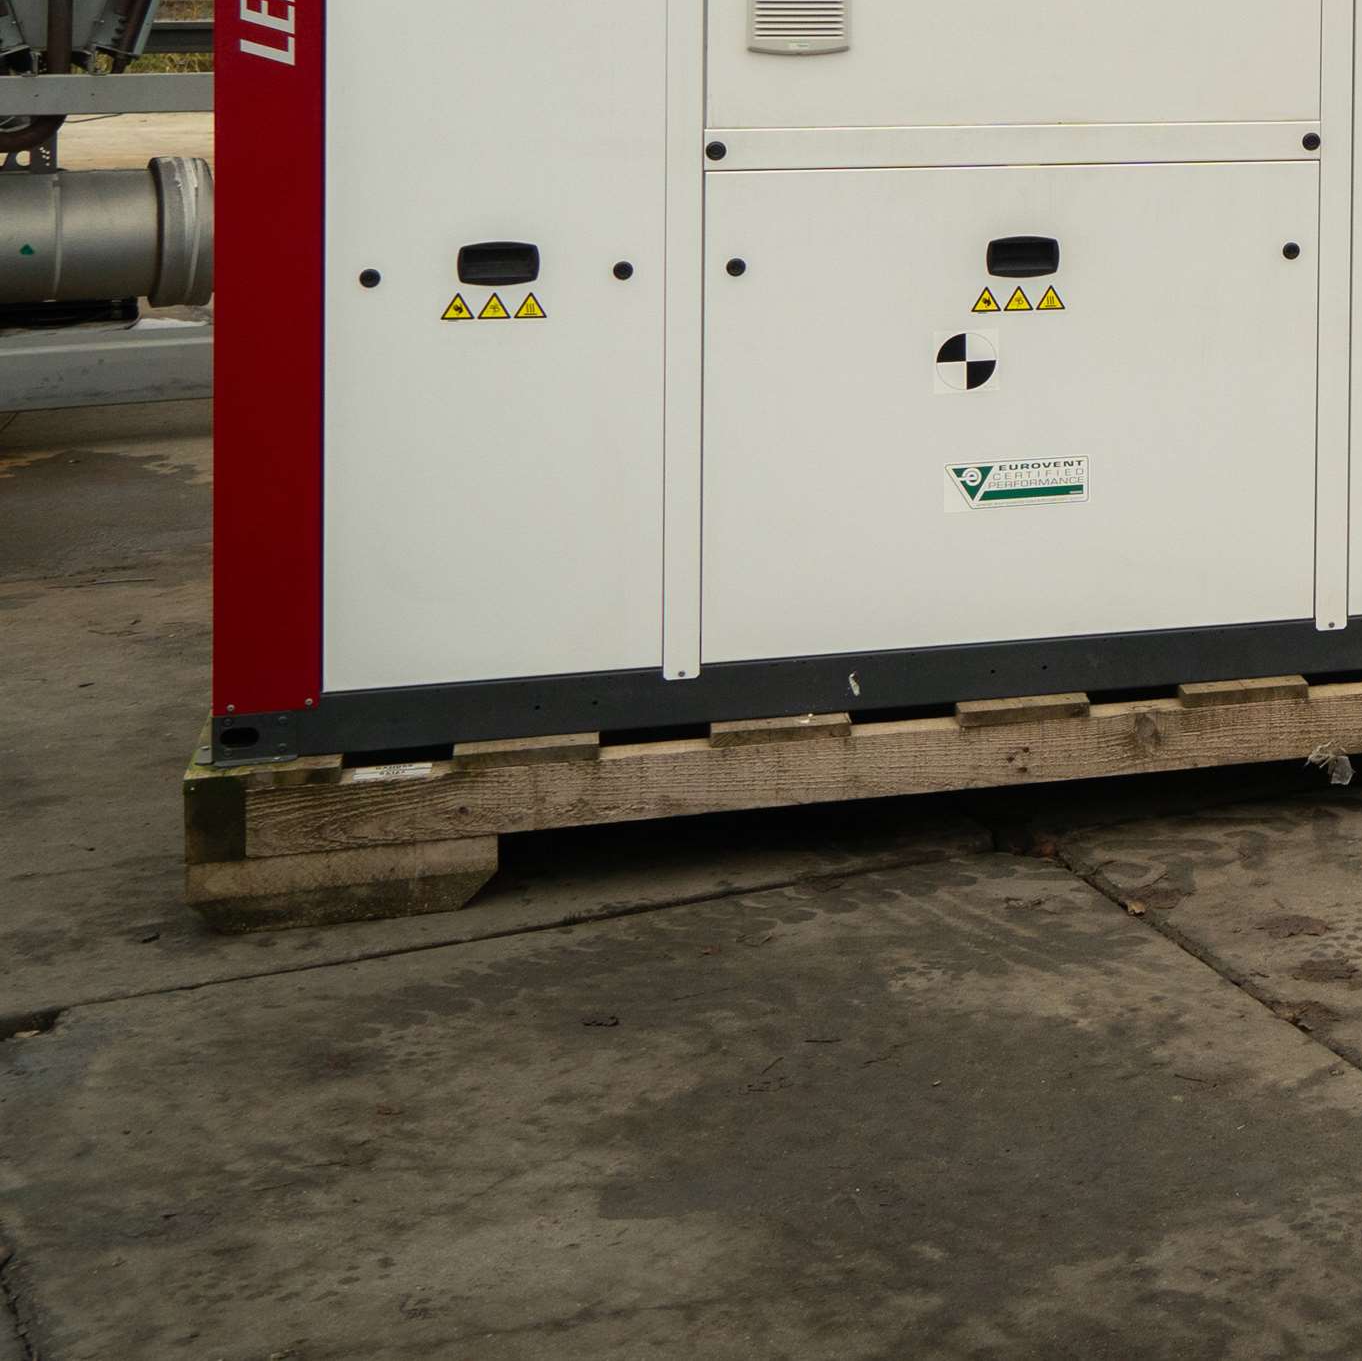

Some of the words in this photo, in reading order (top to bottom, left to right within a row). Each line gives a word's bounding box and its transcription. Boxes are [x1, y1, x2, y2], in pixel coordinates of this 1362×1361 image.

[998, 460, 1083, 471] EUROVENT
[992, 468, 1084, 481] CERTIFIED
[988, 477, 1085, 489] PERFORMANCE
